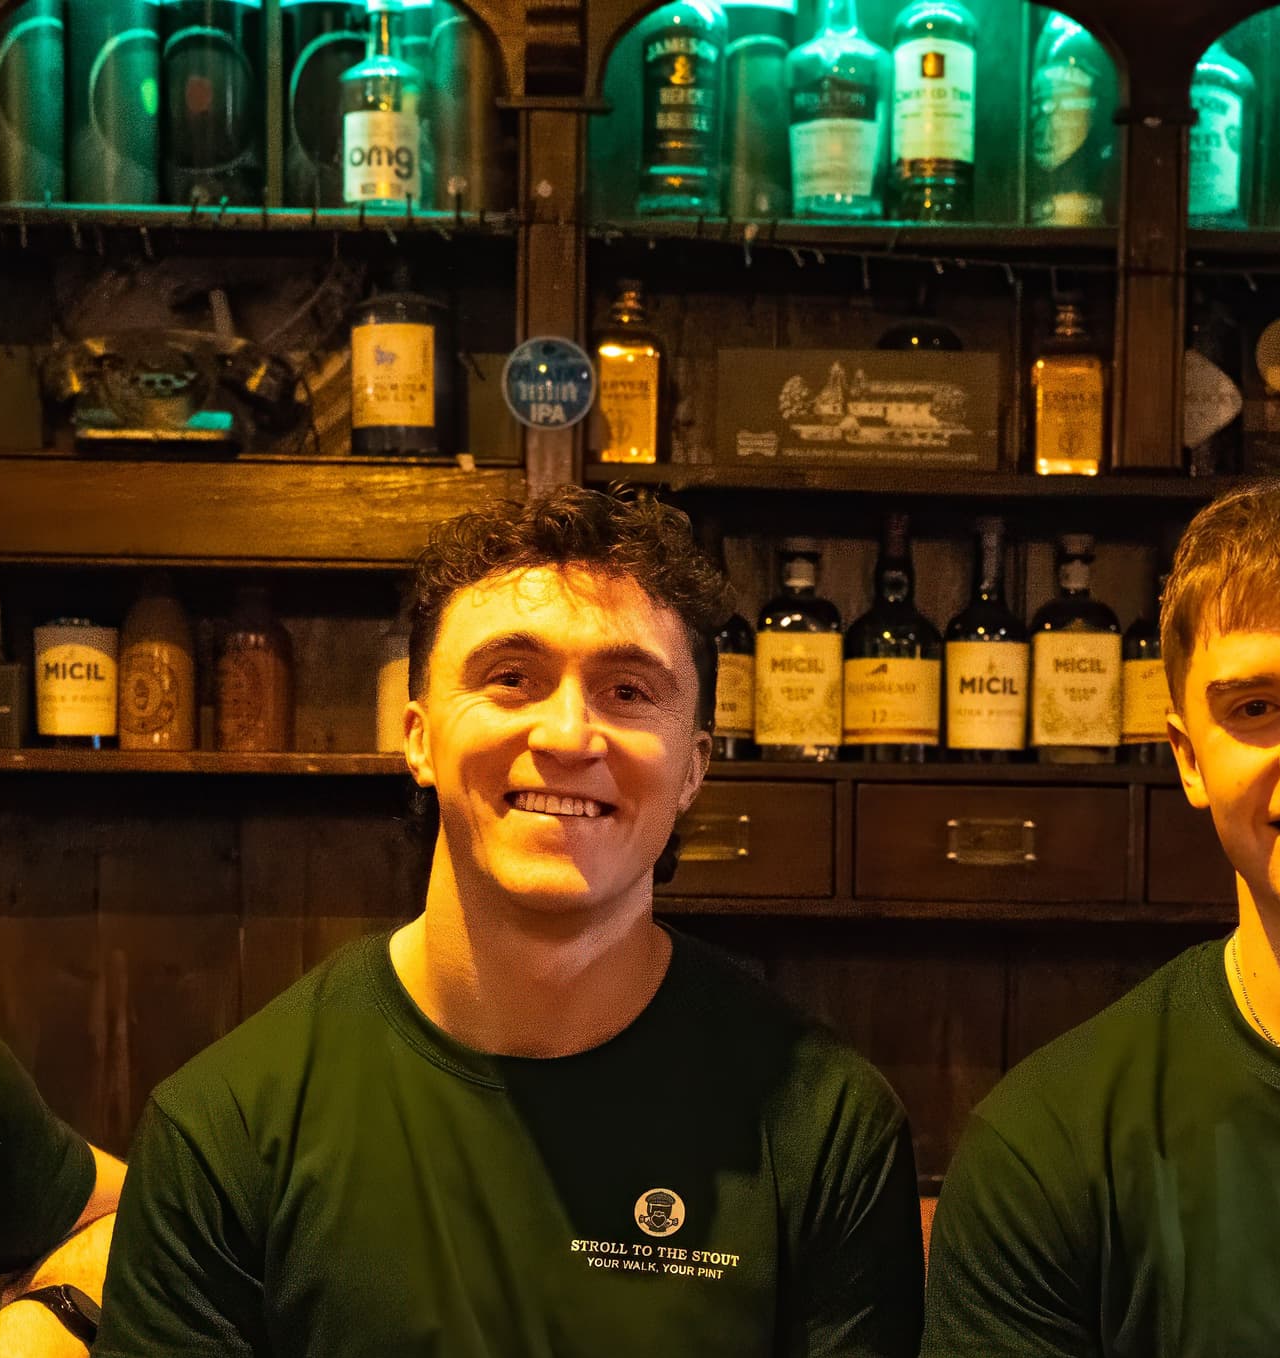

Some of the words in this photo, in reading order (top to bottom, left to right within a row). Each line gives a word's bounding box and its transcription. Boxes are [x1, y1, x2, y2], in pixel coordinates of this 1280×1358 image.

[350, 145, 414, 180] omg
[530, 403, 567, 422] IPA
[44, 662, 106, 681] MICIL
[771, 657, 825, 674] MICIL
[1054, 657, 1107, 674] MICIL
[959, 677, 1019, 696] MICIL
[570, 1239, 628, 1255] STROLL
[632, 1244, 653, 1257] TO
[657, 1246, 687, 1261] THE
[692, 1250, 740, 1267] STOUT
[587, 1257, 619, 1269] YOUR
[623, 1260, 659, 1273] WALK,
[662, 1263, 695, 1276] YOUR
[698, 1267, 724, 1280] PINT
